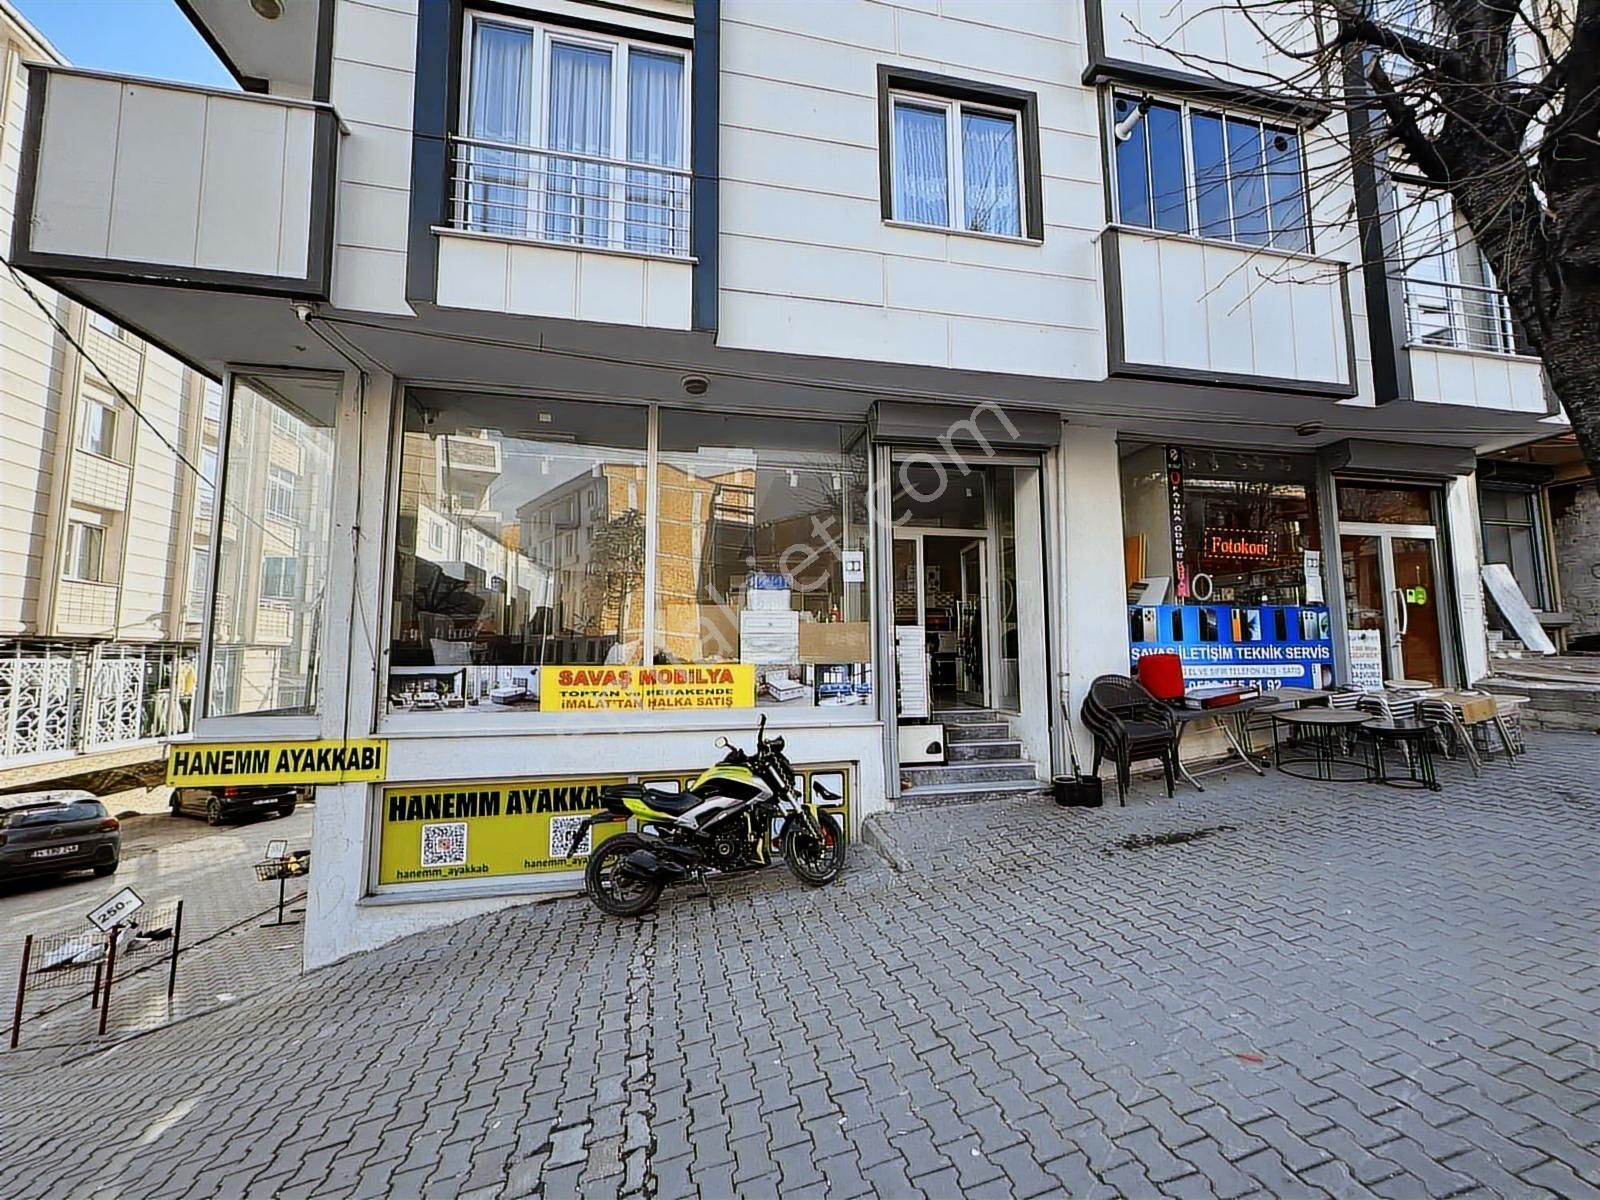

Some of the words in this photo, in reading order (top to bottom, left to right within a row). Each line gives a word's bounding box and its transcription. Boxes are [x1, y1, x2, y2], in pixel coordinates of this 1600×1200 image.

[1236, 644, 1282, 660] TEKNİK
[1285, 644, 1330, 659] SERVİS
[558, 670, 632, 689] SAVAŞ
[648, 697, 693, 708] HALKA
[173, 750, 270, 776] HANEMM
[275, 746, 381, 773] AYAKKABI
[388, 791, 500, 822] HANEMM
[505, 785, 608, 815] AYAKKA
